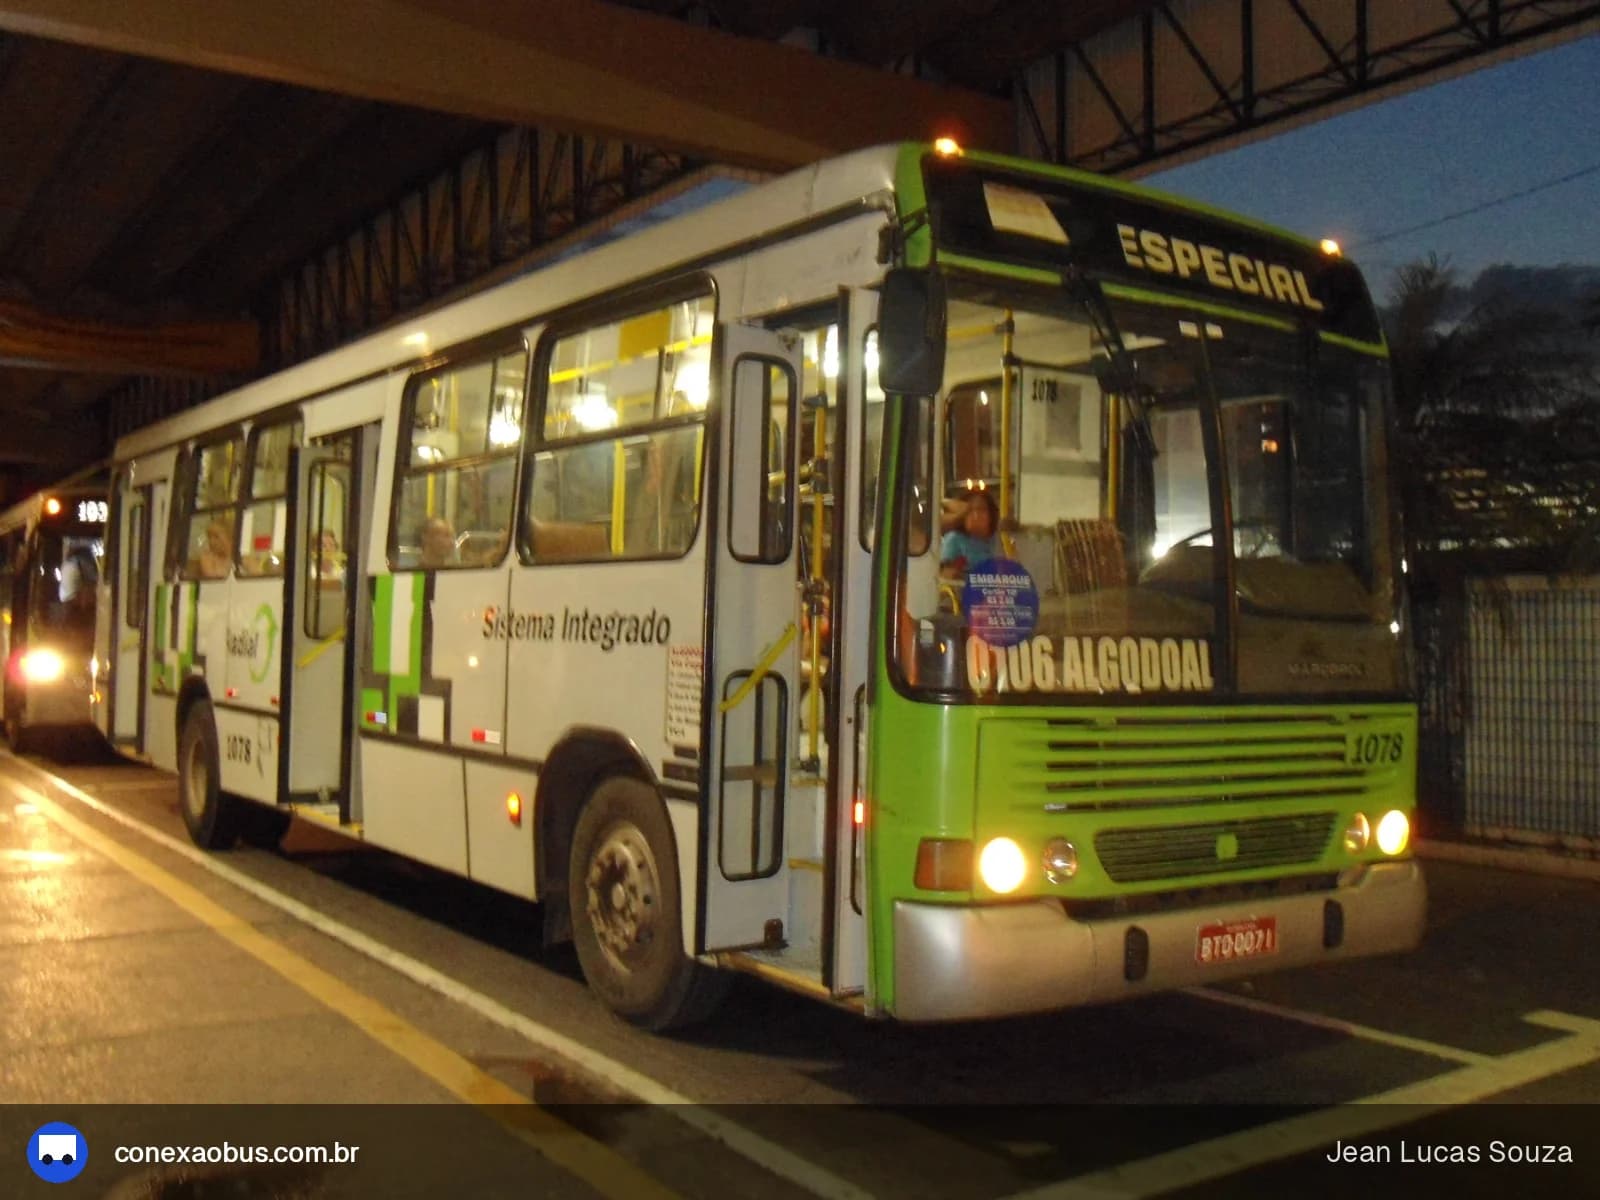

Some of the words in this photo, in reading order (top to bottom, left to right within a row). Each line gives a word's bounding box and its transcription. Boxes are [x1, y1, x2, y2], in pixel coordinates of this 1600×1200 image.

[1117, 223, 1324, 310] ESPECIAL
[969, 574, 1031, 586] EMBARQUE
[481, 605, 554, 640] Sistema
[562, 607, 671, 651] Integrado
[1063, 636, 1214, 694] ALGODOAL
[227, 735, 251, 766] 1078
[1352, 733, 1403, 764] 1078
